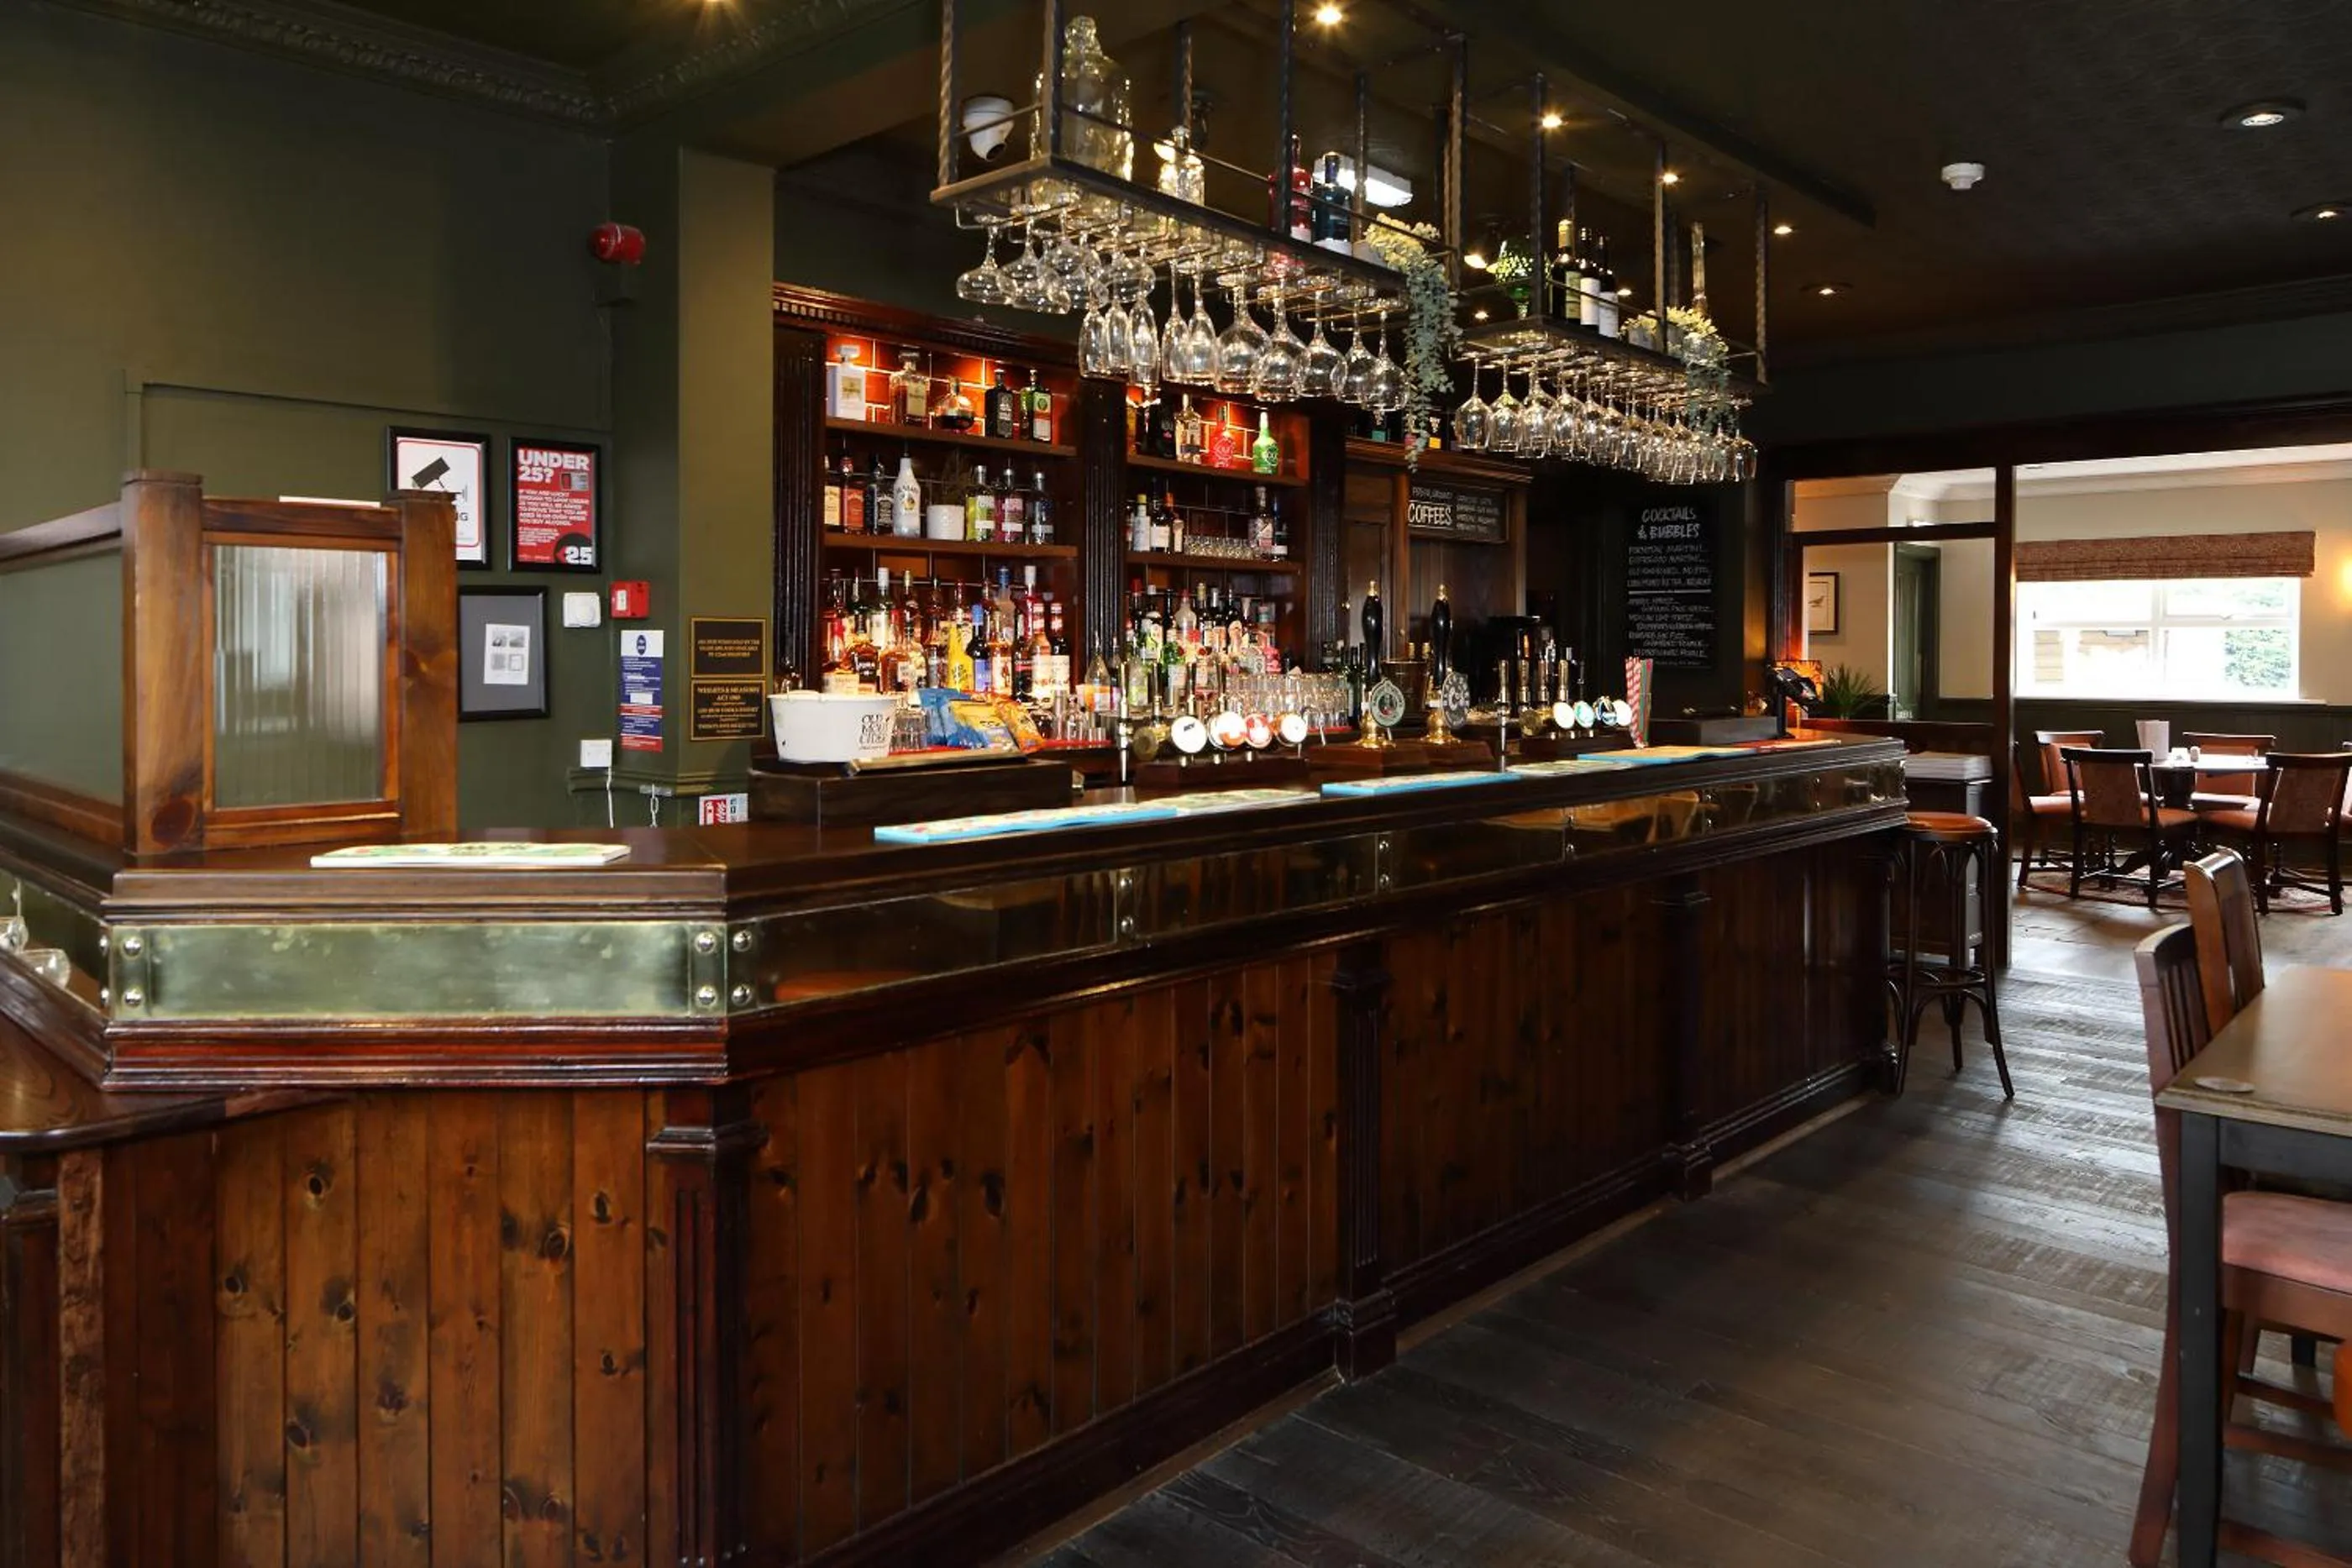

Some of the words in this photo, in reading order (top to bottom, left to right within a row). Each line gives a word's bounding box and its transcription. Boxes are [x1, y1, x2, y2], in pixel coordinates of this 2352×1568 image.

[518, 449, 590, 470] UNDER
[518, 466, 554, 484] 25?
[1408, 502, 1453, 526] COFFEES
[1641, 506, 1697, 523] COCKTAILS
[1638, 523, 1648, 540] &
[1649, 522, 1700, 539] BUBBLES
